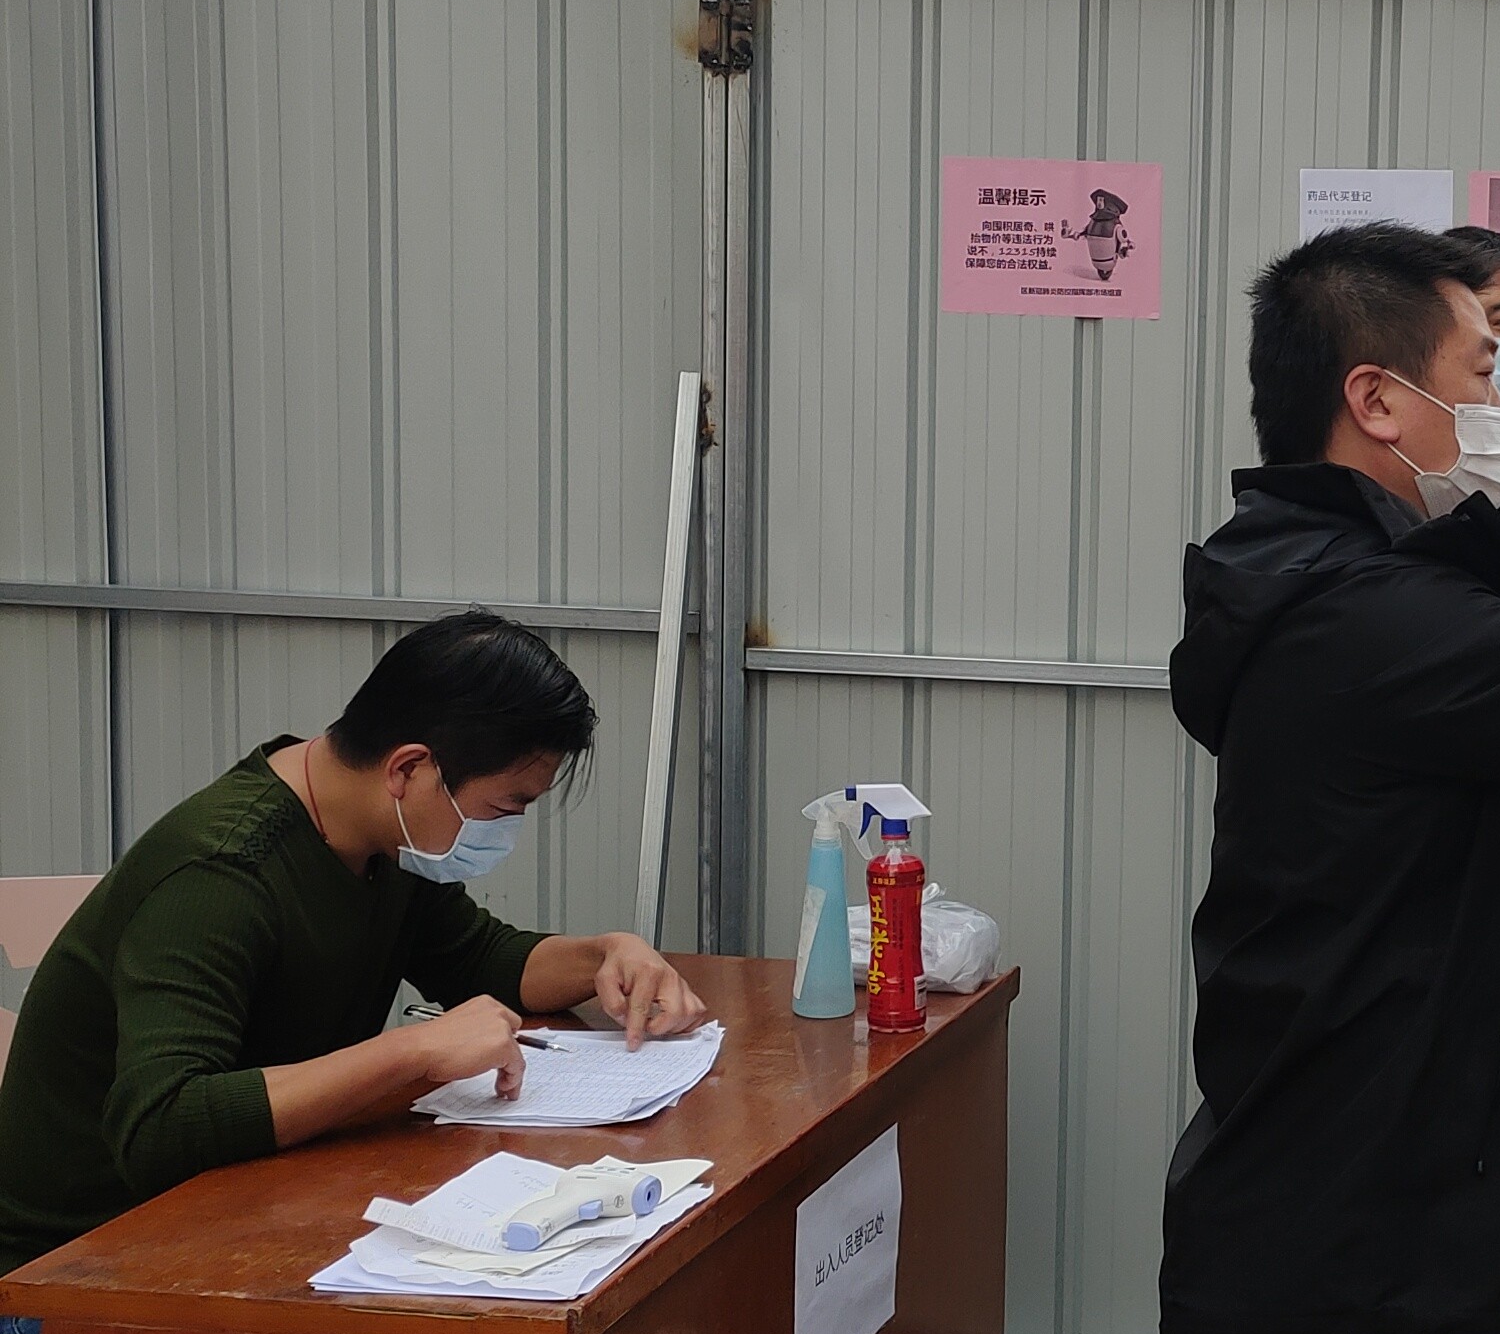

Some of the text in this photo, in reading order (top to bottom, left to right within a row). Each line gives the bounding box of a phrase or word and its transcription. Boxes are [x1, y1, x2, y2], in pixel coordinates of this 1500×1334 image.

[978, 188, 1047, 206] 温馨提示
[1307, 190, 1372, 202] 药品代买登记
[965, 257, 1053, 271] 保障您的合法权益。
[868, 895, 889, 995] 王老吉
[816, 1211, 884, 1287] 出入人员登记处
